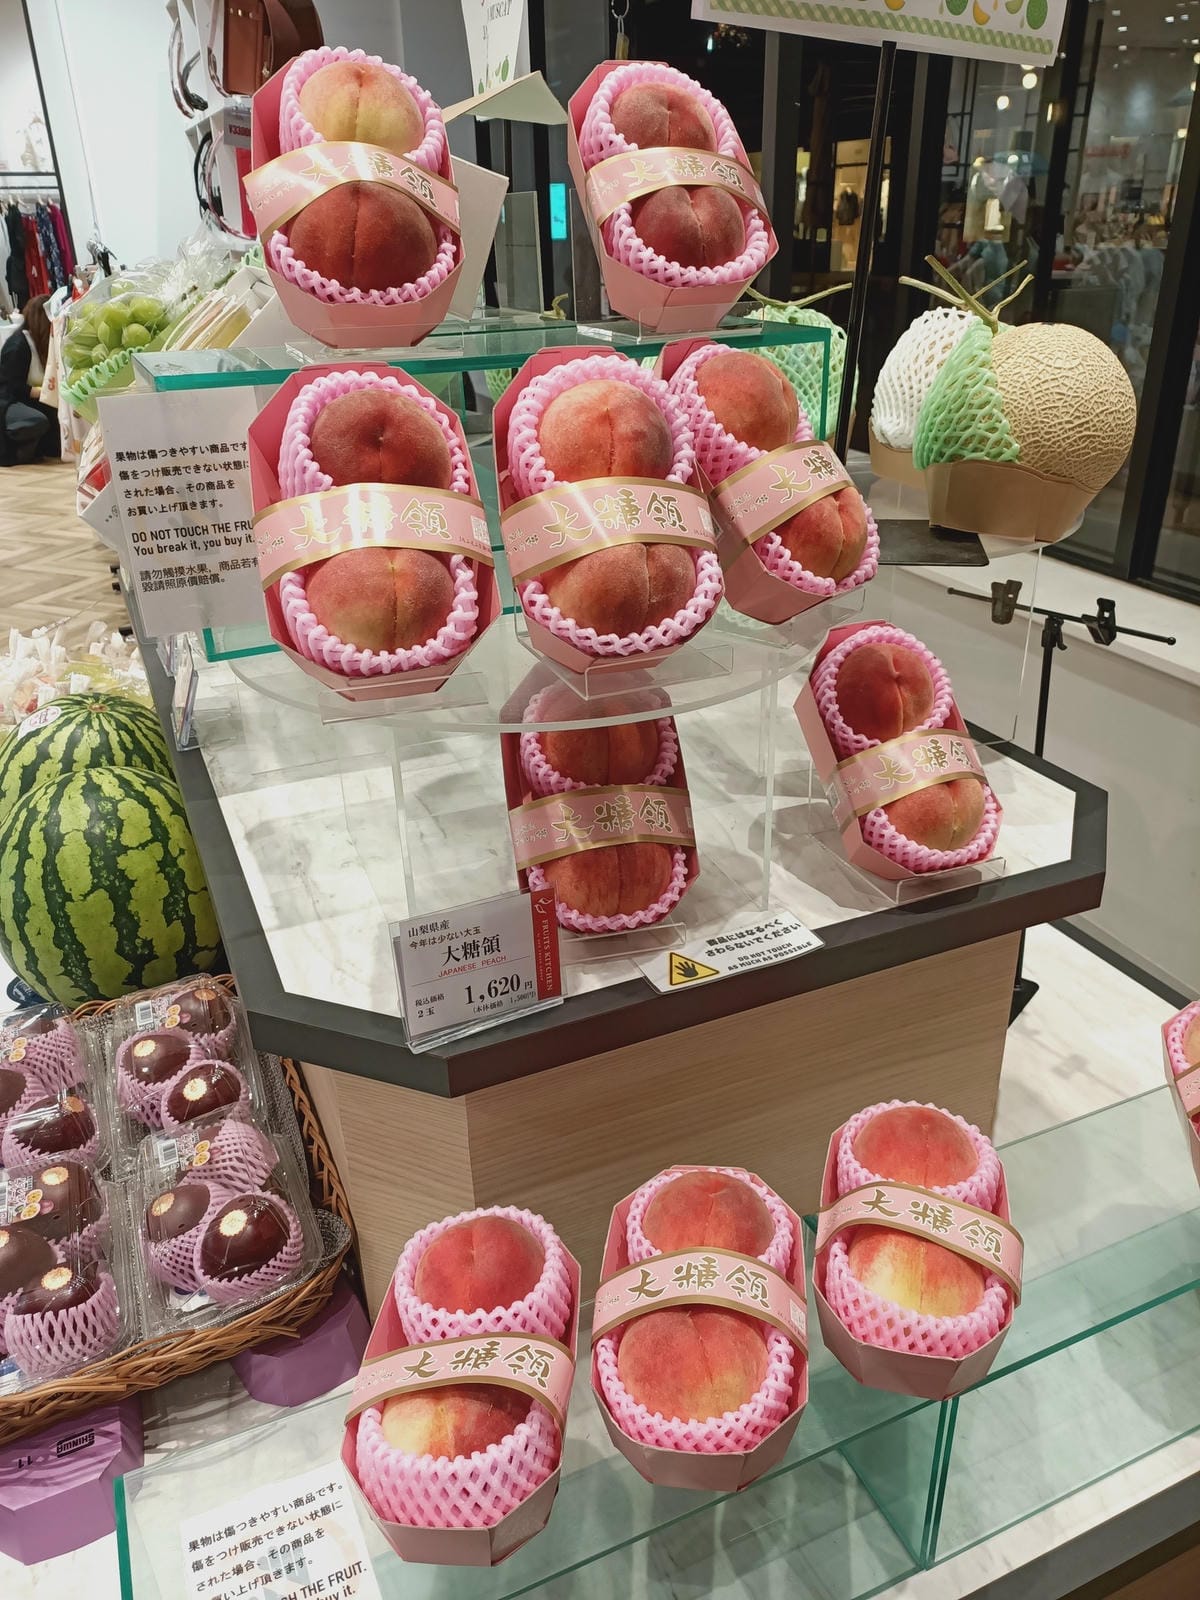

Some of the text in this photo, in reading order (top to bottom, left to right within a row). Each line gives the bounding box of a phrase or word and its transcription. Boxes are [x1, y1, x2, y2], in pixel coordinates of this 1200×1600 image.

[115, 441, 247, 462] 果物は傷つきやすい商品です
[118, 460, 249, 481] 傷をつけ販売できない状態に
[124, 479, 236, 499] された場合、その商品を
[127, 499, 224, 517] お買い上げ頂きます。
[543, 488, 688, 548] 大糖領
[132, 532, 147, 543] DO
[150, 529, 171, 541] NOT
[173, 525, 209, 539] TOUCH
[211, 522, 231, 534] THE
[134, 545, 154, 557] You
[157, 540, 188, 554] break
[190, 540, 200, 551] it,
[204, 539, 221, 551] you
[224, 535, 242, 547] buy
[245, 533, 255, 544] it.
[873, 738, 975, 791] 大糖領
[551, 795, 674, 842] 大糖領
[408, 920, 450, 938] 山梨県産
[409, 926, 481, 949] 今年は少ない大玉
[705, 923, 801, 957] さわらないでください
[706, 918, 783, 947] 商品にはなるべく
[441, 934, 501, 967] 大糖領
[541, 919, 553, 991] FRUITS KITCHEN
[739, 958, 762, 968] MUCH
[773, 941, 813, 959] POSSIBLE
[750, 950, 766, 959] NOT
[767, 942, 793, 954] TOUCH
[438, 955, 507, 978] JAPANESE PEACH
[415, 993, 445, 1007] 税込価格
[464, 973, 521, 1006] 1,620
[861, 1189, 1003, 1263] 大糖領
[627, 1255, 770, 1309] 大糖領
[401, 1340, 555, 1388] 大糖領
[57, 1432, 95, 1454] SHINWA
[188, 1482, 343, 1553] 果物は傷つきやすい商品です。
[191, 1500, 344, 1573] 傷をつけ販売できない状態に
[196, 1527, 326, 1592] された場合、その商品を
[299, 1561, 368, 1599] THE FRUIT.
[342, 1584, 356, 1598] it.
